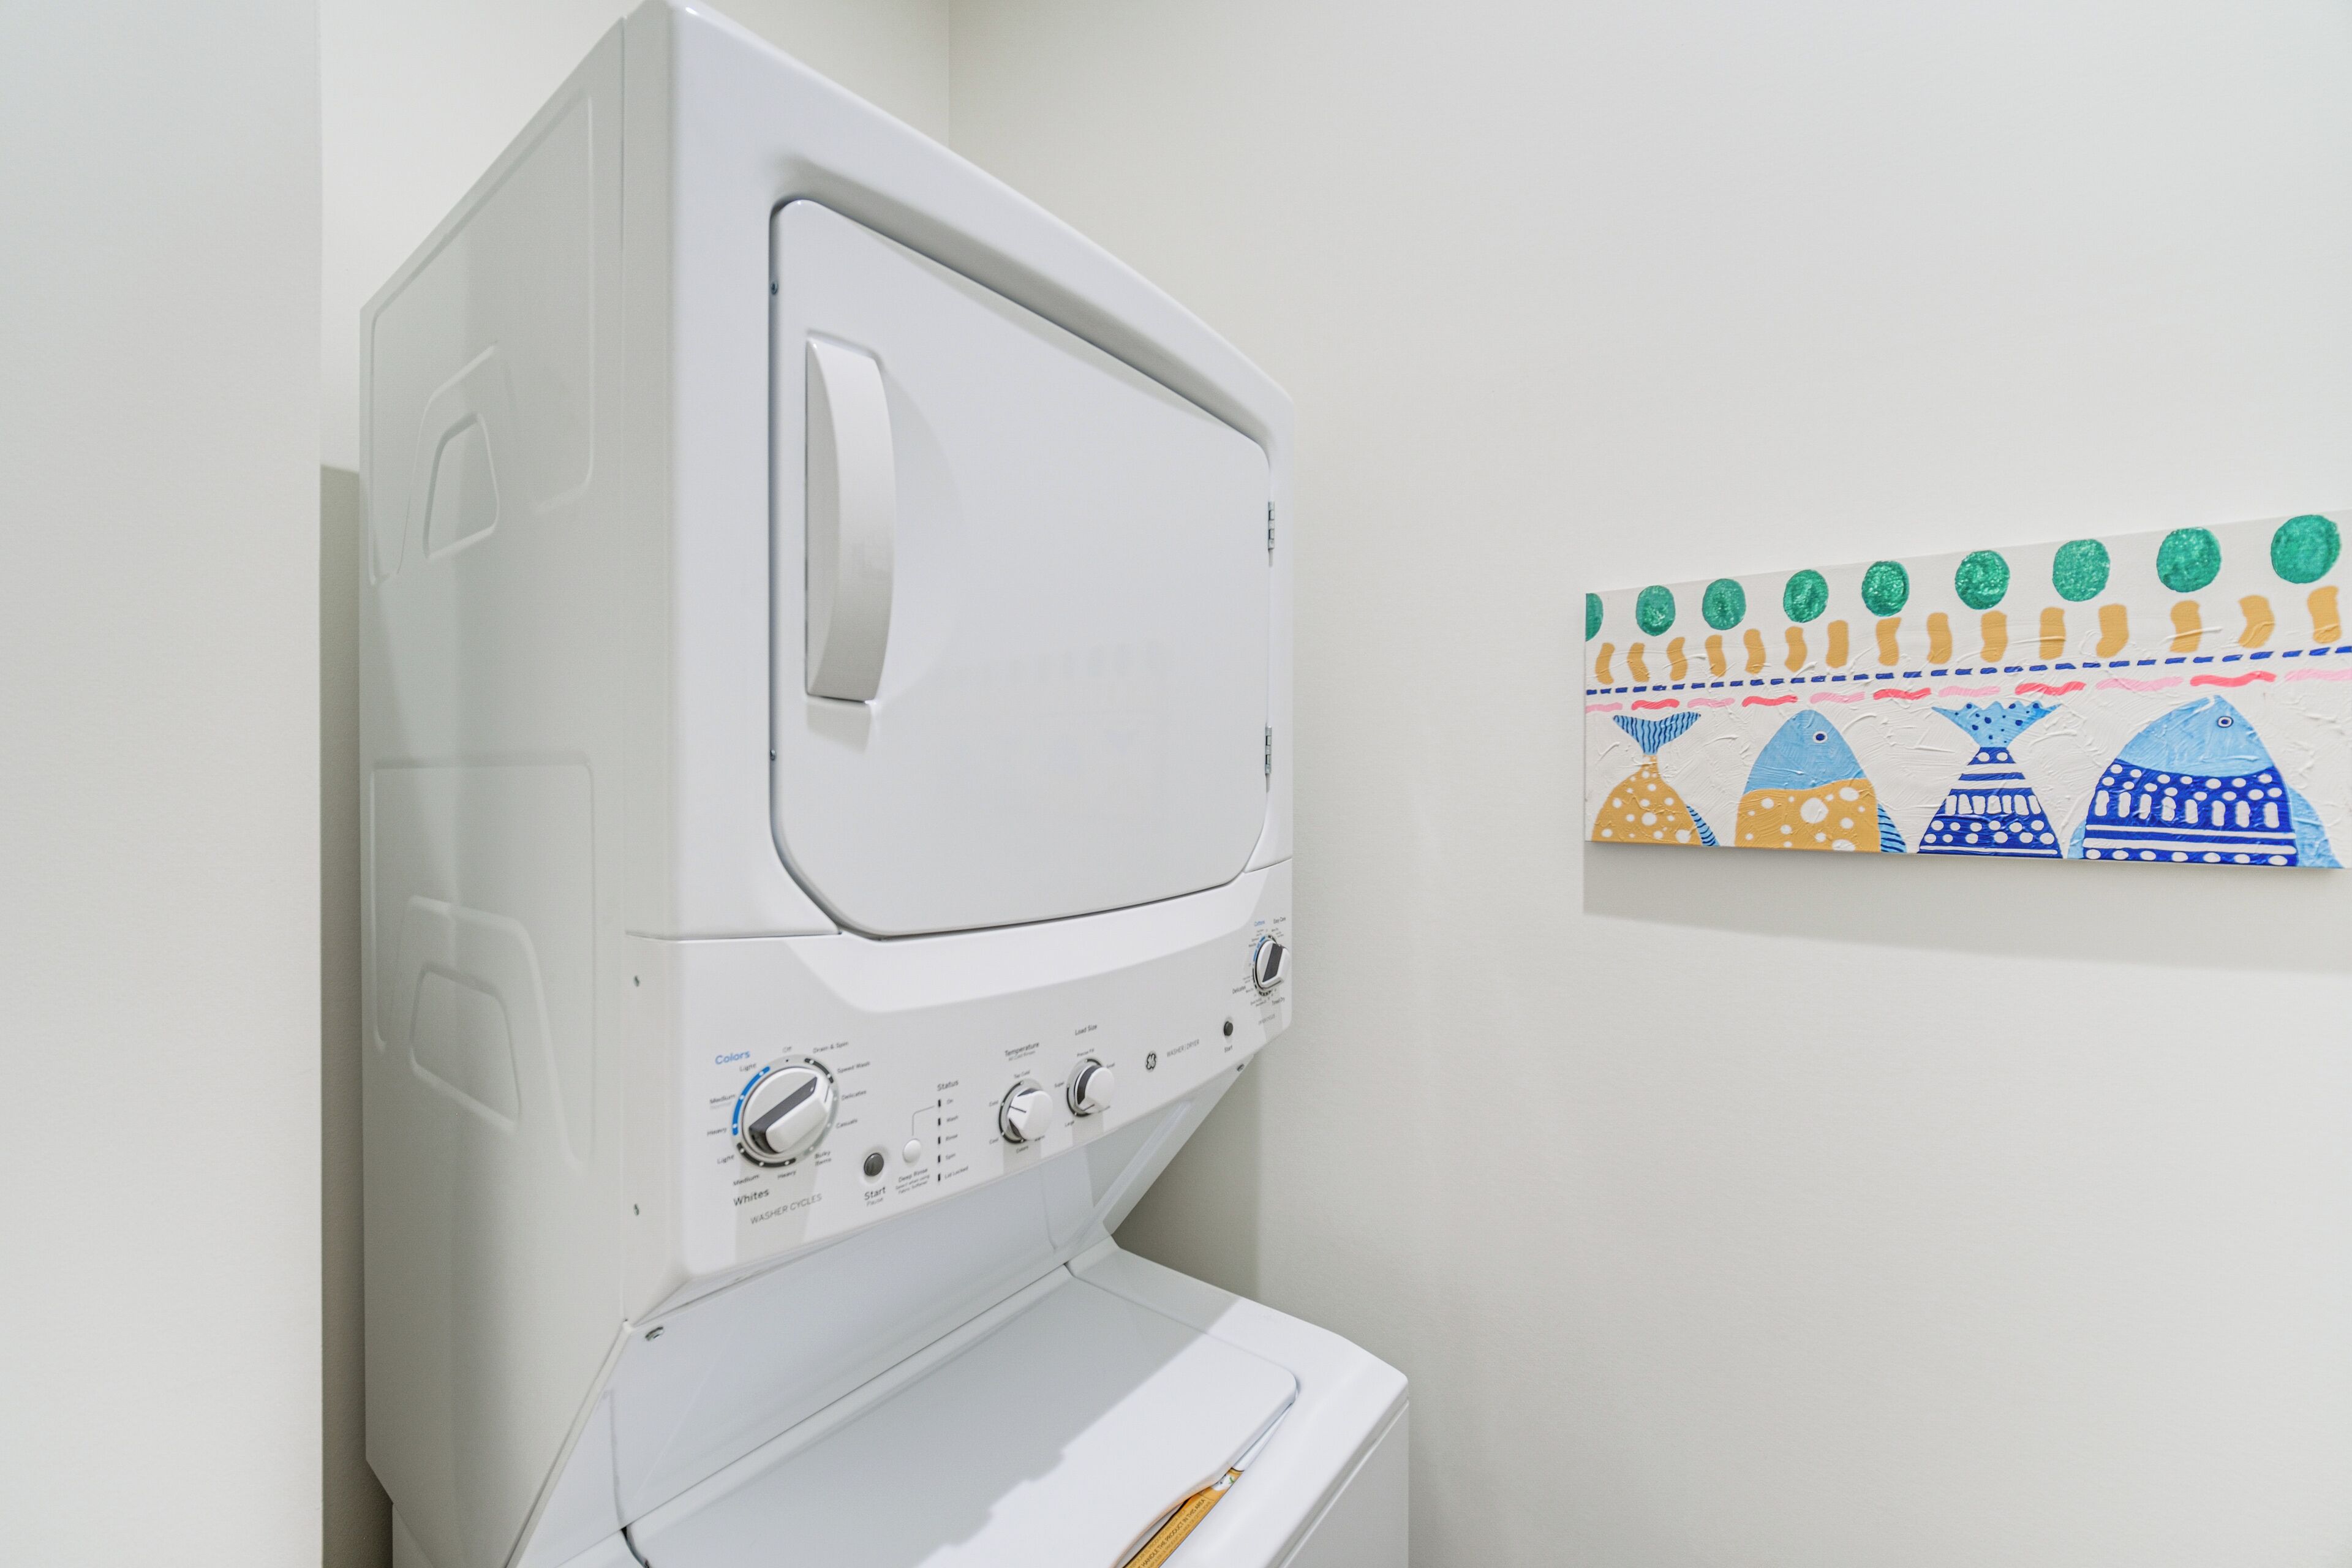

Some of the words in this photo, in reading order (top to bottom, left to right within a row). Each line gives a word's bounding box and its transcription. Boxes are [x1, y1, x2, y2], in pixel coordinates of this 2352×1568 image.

[1075, 1027, 1087, 1036] Load
[1005, 1042, 1040, 1057] Temperature
[1167, 1045, 1185, 1058] WASHER
[1186, 1039, 1200, 1050] DRYER
[1224, 1044, 1233, 1053] Start
[715, 1050, 750, 1065] Colors
[739, 1063, 757, 1072] Light
[837, 1065, 854, 1074] Speed
[937, 1080, 959, 1091] Status
[709, 1094, 736, 1104] Medium
[842, 1090, 867, 1101] Delicates
[837, 1118, 858, 1129] Casuals
[707, 1127, 728, 1136] Heavy
[717, 1155, 735, 1165] Light
[815, 1158, 832, 1166] Items
[777, 1170, 796, 1180] Heavy
[952, 1166, 969, 1176] Locked
[733, 1174, 760, 1186] Medium
[899, 1175, 913, 1183] Deep
[733, 1189, 769, 1206] Whites
[864, 1186, 886, 1201] Start
[750, 1204, 789, 1225] WASHER
[790, 1193, 822, 1211] CYCLES
[1142, 1549, 1158, 1567] HANDLE
[1158, 1541, 1167, 1551] THE
[1164, 1522, 1184, 1542] PRODUCT
[1188, 1508, 1197, 1519] THIS
[1196, 1498, 1205, 1509] AREA
